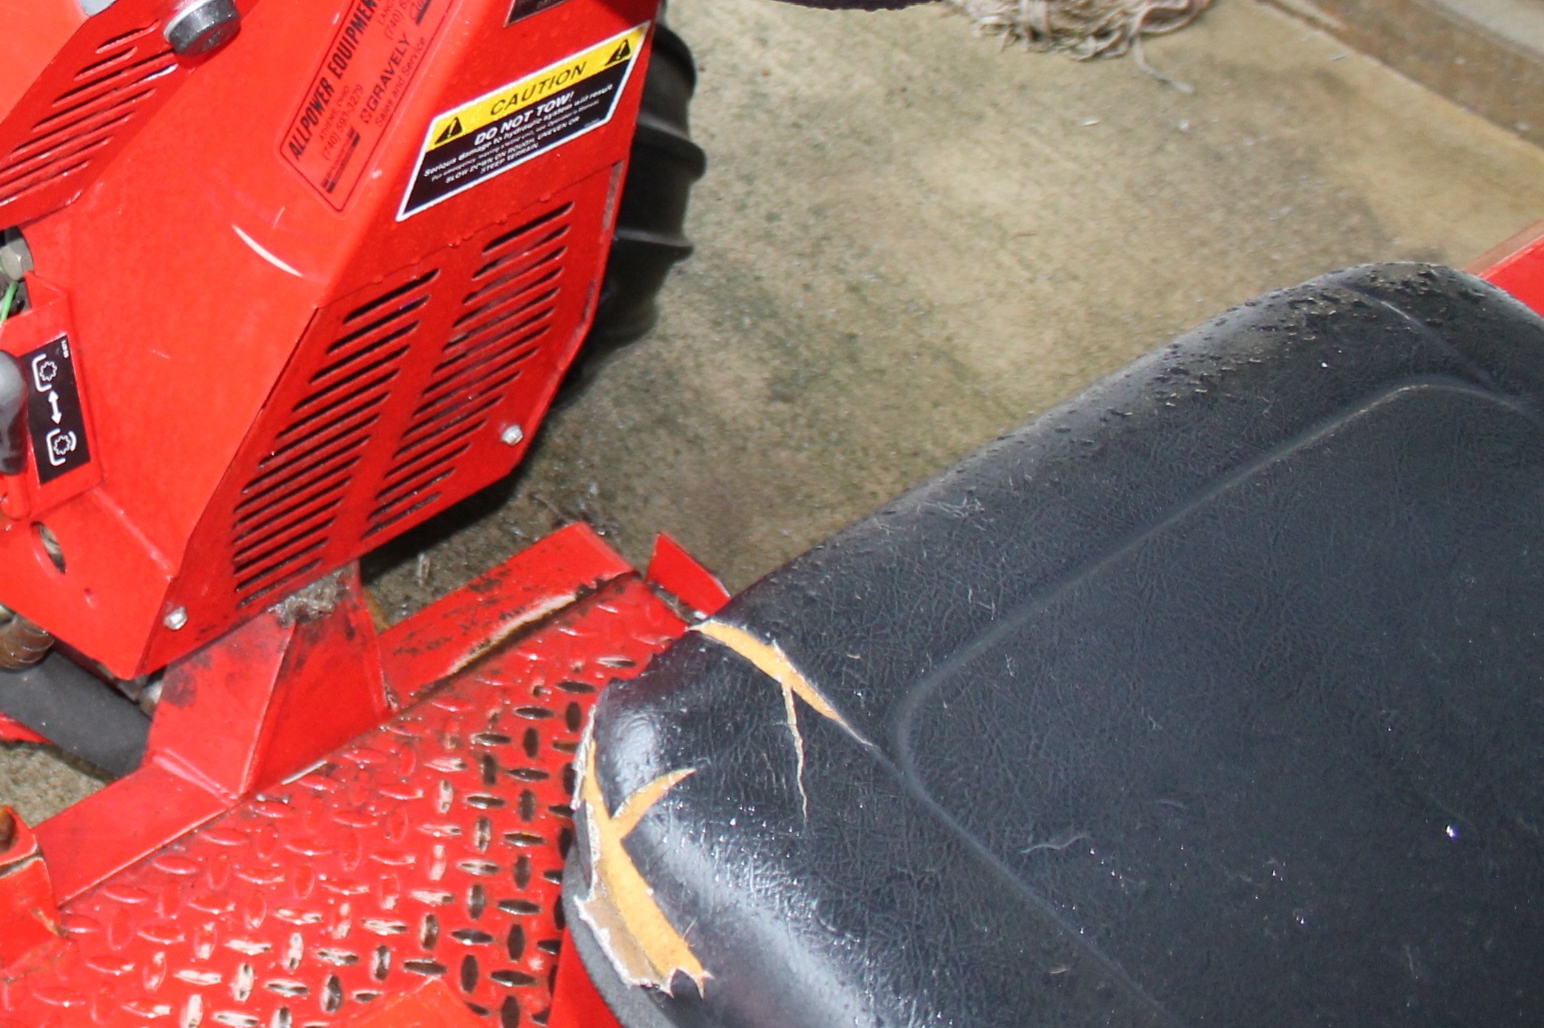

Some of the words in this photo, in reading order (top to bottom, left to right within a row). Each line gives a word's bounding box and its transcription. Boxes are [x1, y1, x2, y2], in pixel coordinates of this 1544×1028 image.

[367, 30, 410, 112] GRAVELY
[375, 99, 394, 128] Sales
[392, 75, 407, 99] and
[401, 36, 427, 78] Service
[491, 61, 588, 117] CAUTION
[288, 76, 335, 162] ALLPOWER
[474, 127, 498, 146] DO
[500, 110, 534, 134] NOT
[537, 90, 575, 116] TOW!
